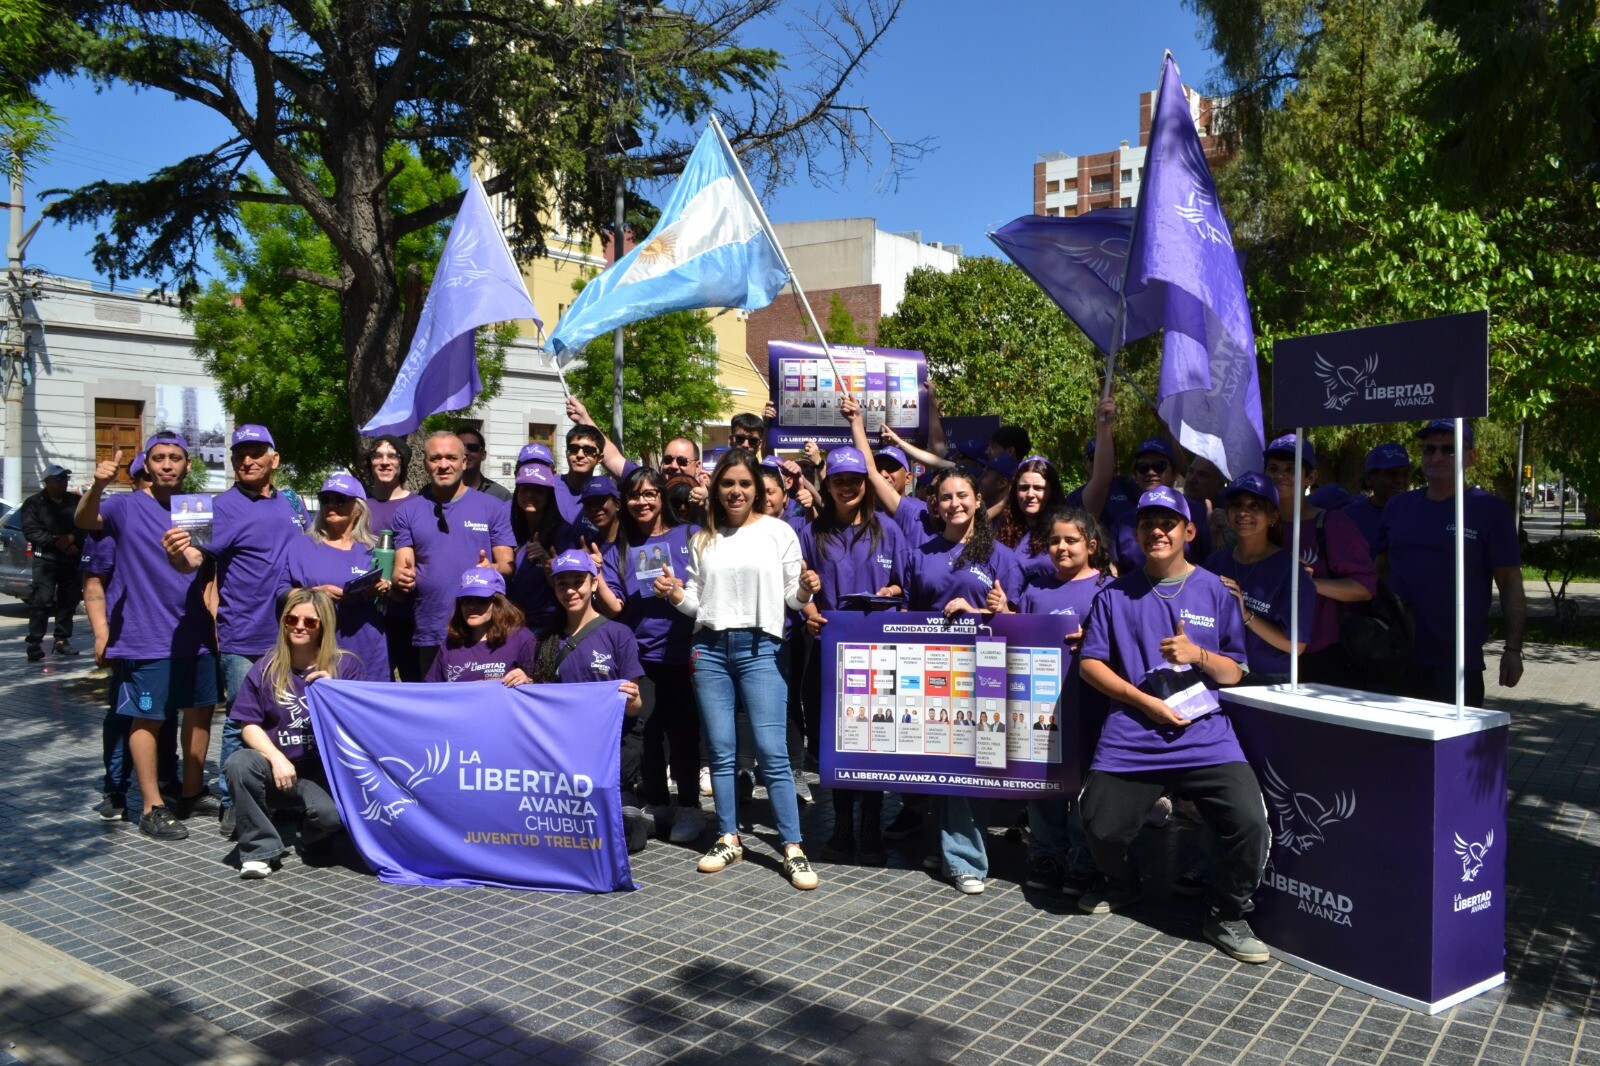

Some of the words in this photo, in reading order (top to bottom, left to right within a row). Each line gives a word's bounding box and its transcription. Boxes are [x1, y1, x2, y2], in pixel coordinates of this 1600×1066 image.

[1365, 379, 1376, 388] LA
[1365, 383, 1435, 400] LIBERTAD
[1394, 396, 1434, 408] AVANZA
[1242, 595, 1271, 609] IBERTAD
[1180, 612, 1215, 622] LIBERTAD
[1189, 619, 1214, 628] AVANZA
[471, 663, 506, 671] LIBERTAD
[279, 735, 314, 746] LIBER
[459, 750, 481, 764] LA
[459, 768, 594, 798] LIBERTAD
[852, 772, 896, 780] LIBERTAD
[898, 774, 937, 782] AVANZA
[948, 776, 1001, 787] ARGENTINA
[1003, 780, 1060, 790] RETROCEDE
[518, 796, 598, 816] AVANZA
[525, 815, 595, 835] CHUBUT
[463, 831, 540, 847] JUVENTUD
[544, 835, 603, 850] TRELEW
[1262, 871, 1353, 913] LIBERTAD
[1454, 892, 1462, 901] LA
[1454, 890, 1492, 912] LIBERTAD
[1471, 900, 1491, 914] AVANZA
[1297, 899, 1352, 928] AVANZA
